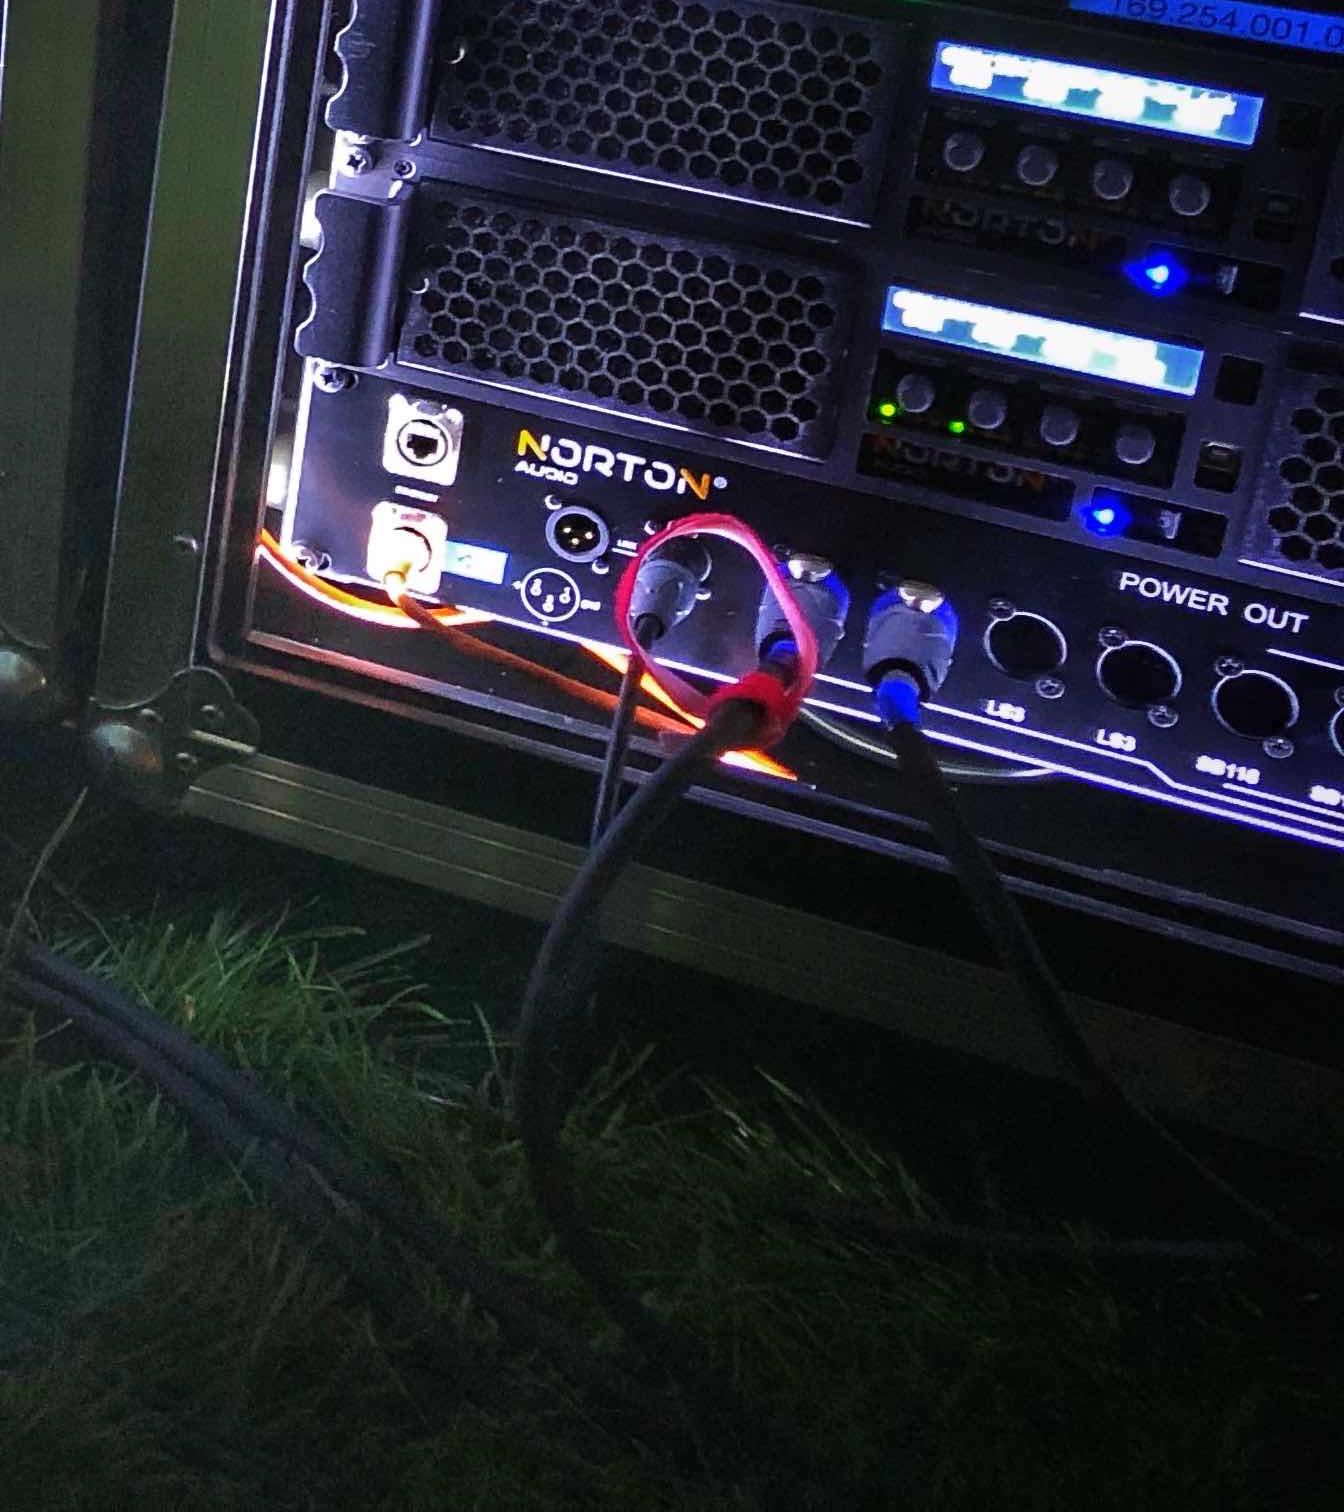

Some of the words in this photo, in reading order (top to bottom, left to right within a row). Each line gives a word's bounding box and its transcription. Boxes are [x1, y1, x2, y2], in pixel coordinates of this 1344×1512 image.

[514, 459, 579, 486] AUDIO
[517, 429, 711, 500] NORTON
[1118, 570, 1229, 617] POWER
[1244, 602, 1310, 634] OUT
